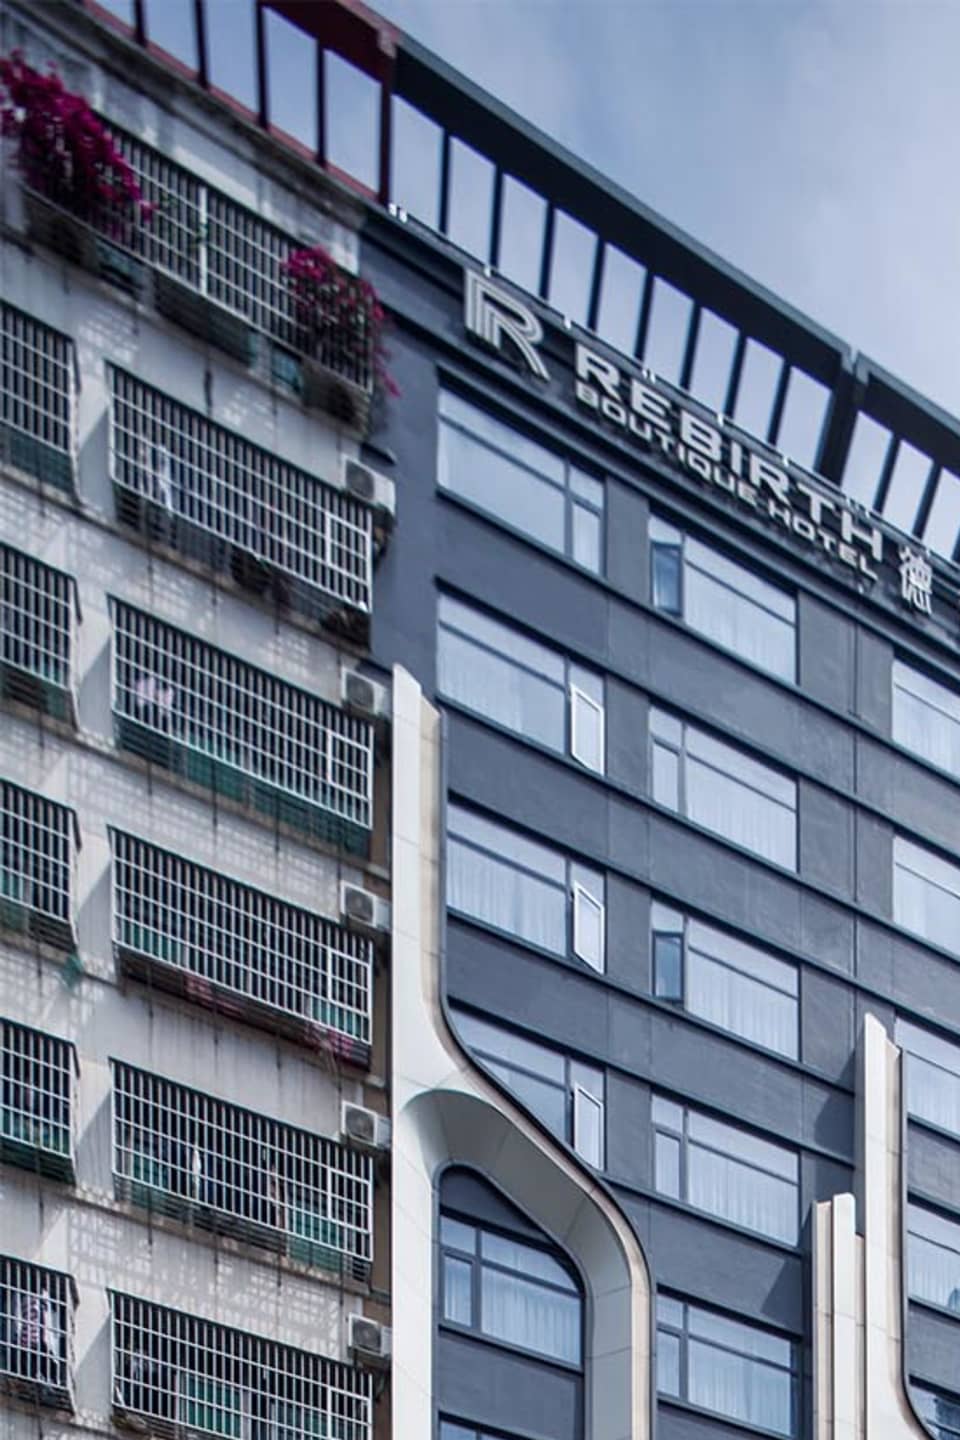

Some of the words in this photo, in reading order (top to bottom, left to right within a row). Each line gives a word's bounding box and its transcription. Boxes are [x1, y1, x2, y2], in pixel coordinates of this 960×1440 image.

[575, 342, 883, 562] REBIRTH
[575, 381, 758, 508] BOUTIQUE
[767, 498, 878, 582] HOTEL
